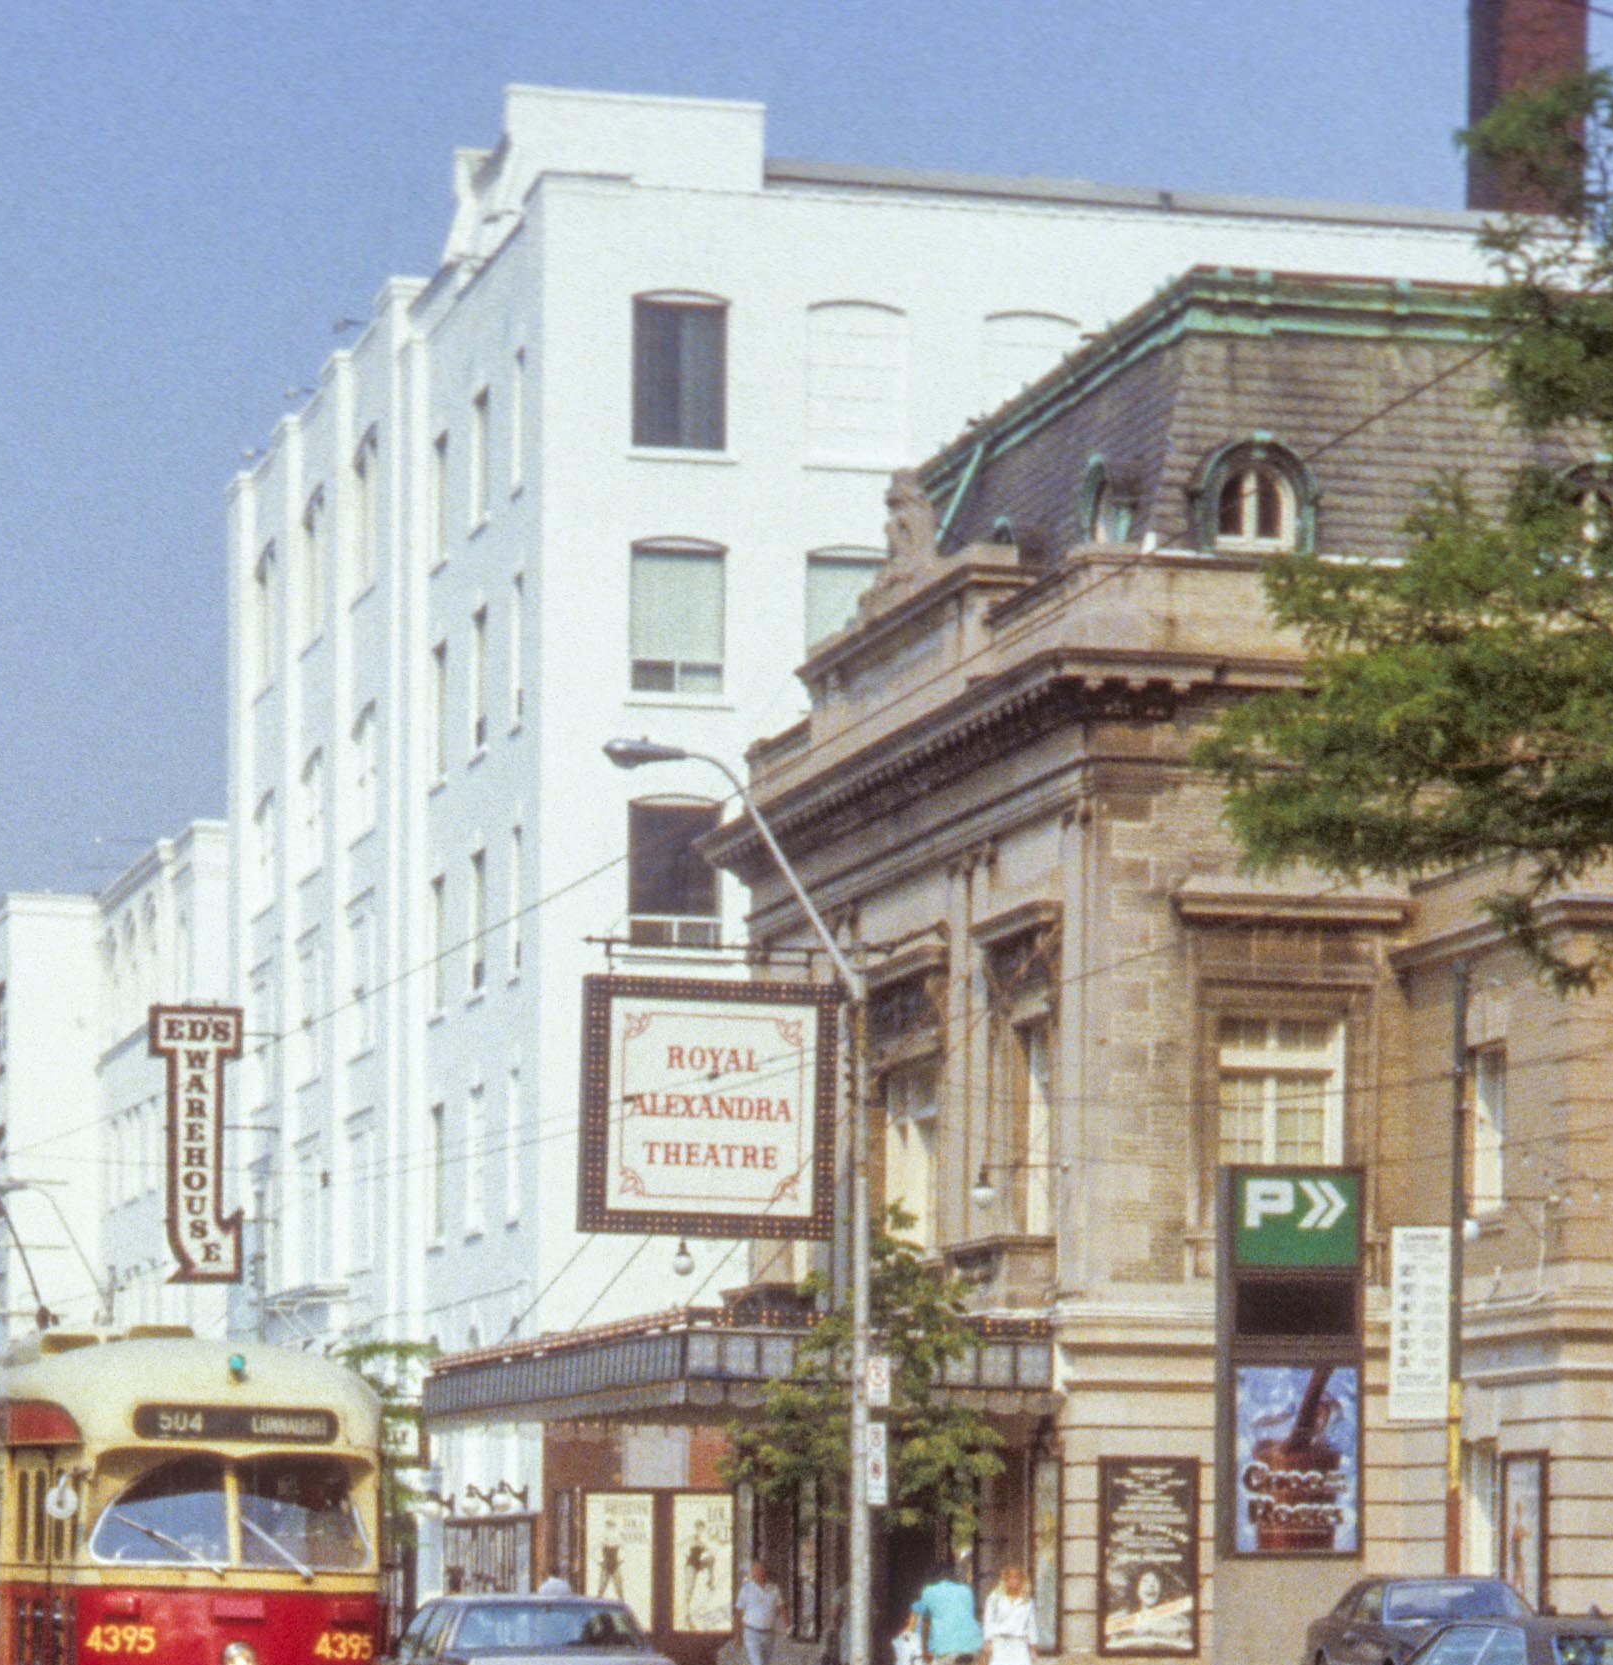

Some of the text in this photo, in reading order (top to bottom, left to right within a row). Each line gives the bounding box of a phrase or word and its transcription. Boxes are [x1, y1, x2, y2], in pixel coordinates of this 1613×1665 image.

[164, 1017, 231, 1042] ED'S
[666, 1045, 760, 1073] ROYAL
[629, 1092, 792, 1122] ALEXANDRA
[183, 1050, 221, 1263] WAREHOUSE
[642, 1141, 779, 1170] THEATRE
[1245, 1179, 1295, 1229] P
[157, 1411, 204, 1433] 504
[86, 1625, 156, 1654] 4395
[314, 1631, 373, 1660] 4395
